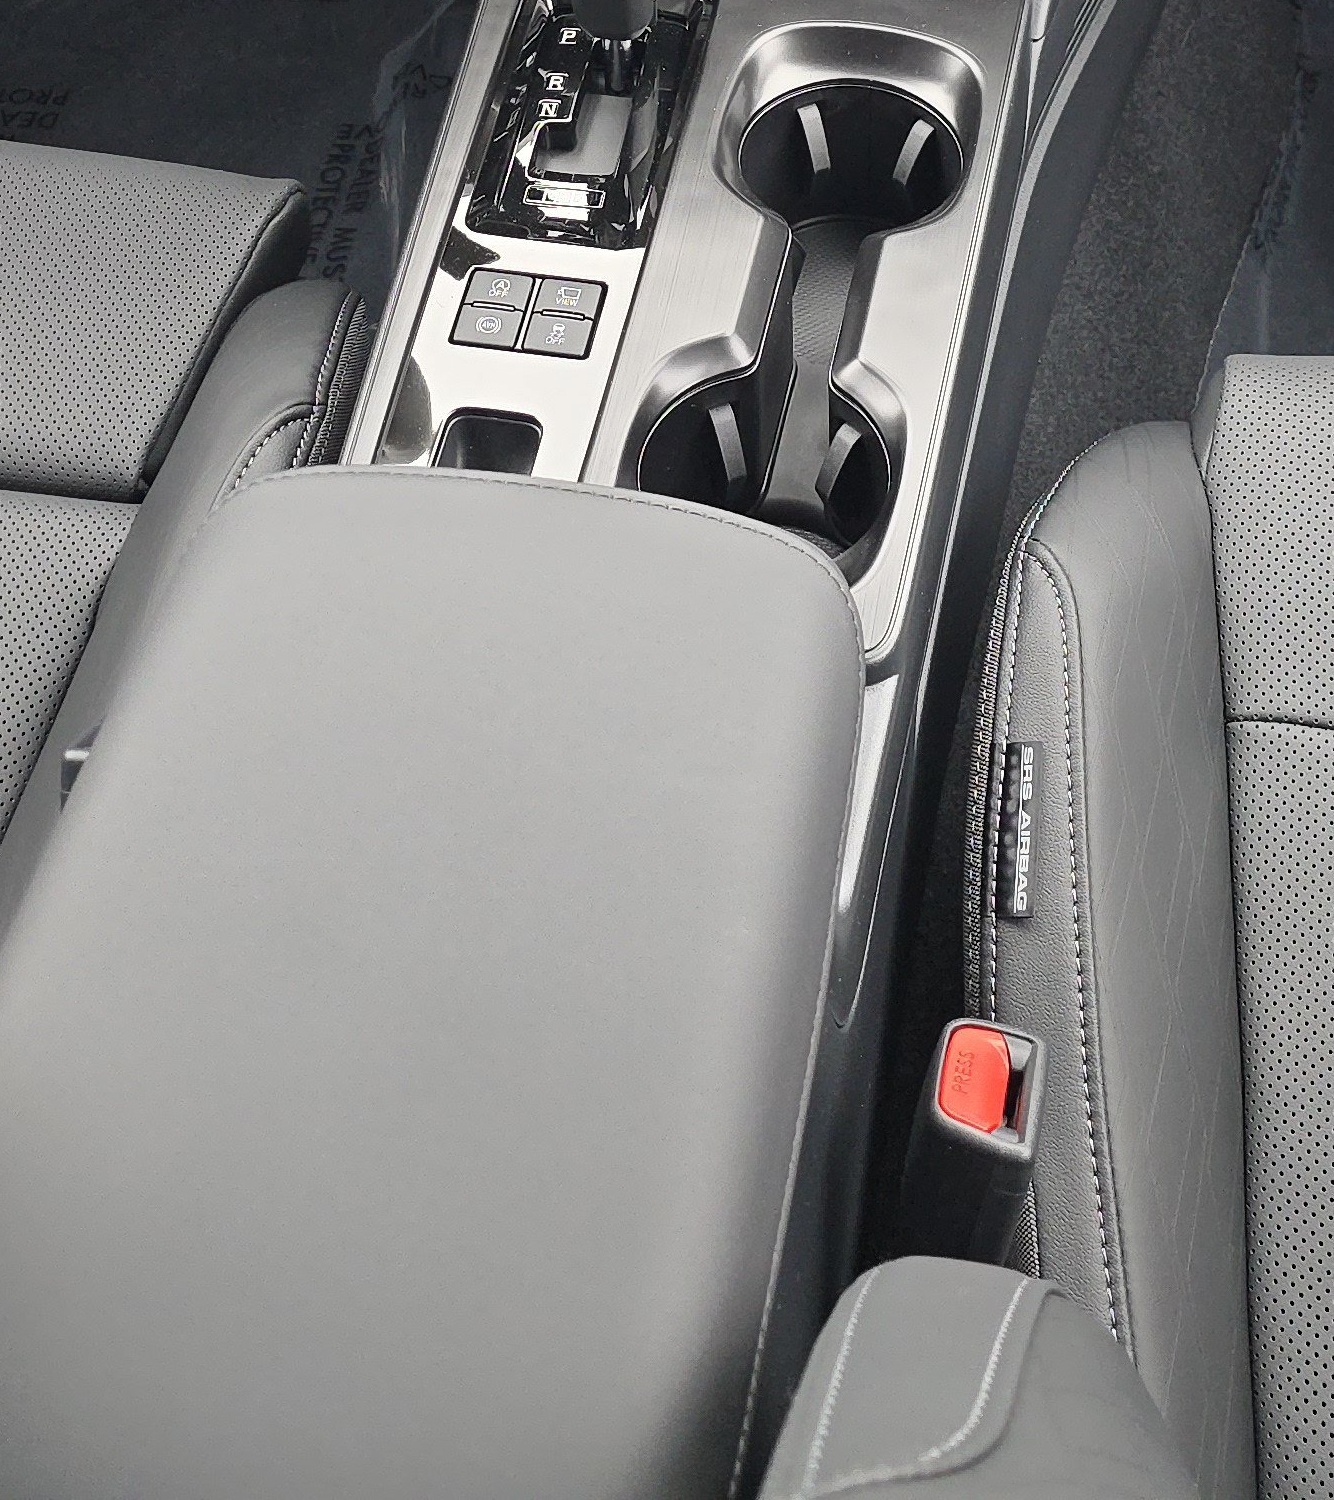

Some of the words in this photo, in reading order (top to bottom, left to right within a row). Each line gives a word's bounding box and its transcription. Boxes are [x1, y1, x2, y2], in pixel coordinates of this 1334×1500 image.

[559, 29, 578, 45] P
[546, 75, 565, 91] R
[539, 102, 560, 118] N
[321, 227, 358, 283] MUS
[488, 288, 509, 298] OFF
[555, 297, 579, 307] VIEW
[545, 336, 566, 346] OFF
[1021, 746, 1034, 801] SRS
[1016, 809, 1032, 912] AIRBAG
[951, 1050, 975, 1095] PRESS
